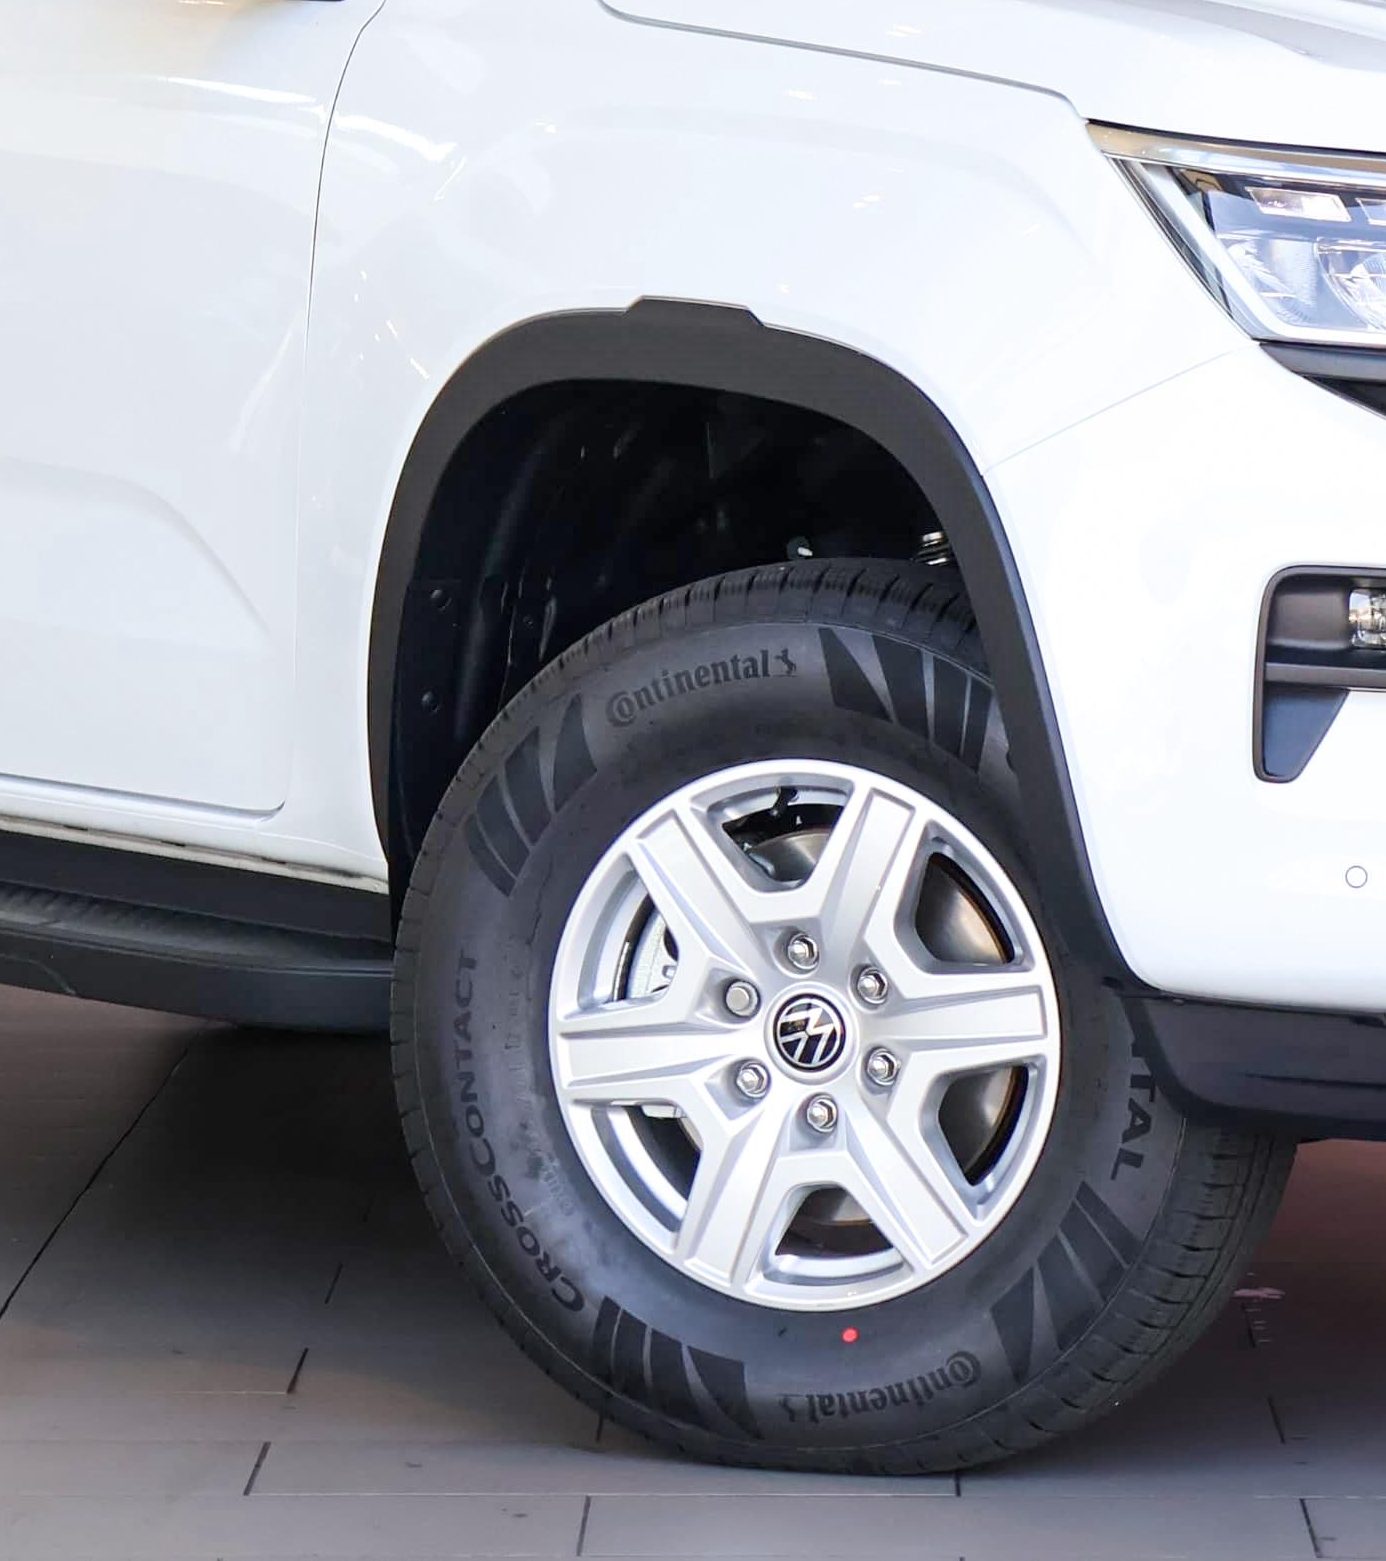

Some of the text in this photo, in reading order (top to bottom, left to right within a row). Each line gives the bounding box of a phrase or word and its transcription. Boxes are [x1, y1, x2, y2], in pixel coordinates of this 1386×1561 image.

[605, 649, 771, 727] Continental
[453, 949, 585, 1313] CROSSCONTACT
[1110, 1040, 1158, 1181] TAL
[805, 1350, 982, 1424] Continental
